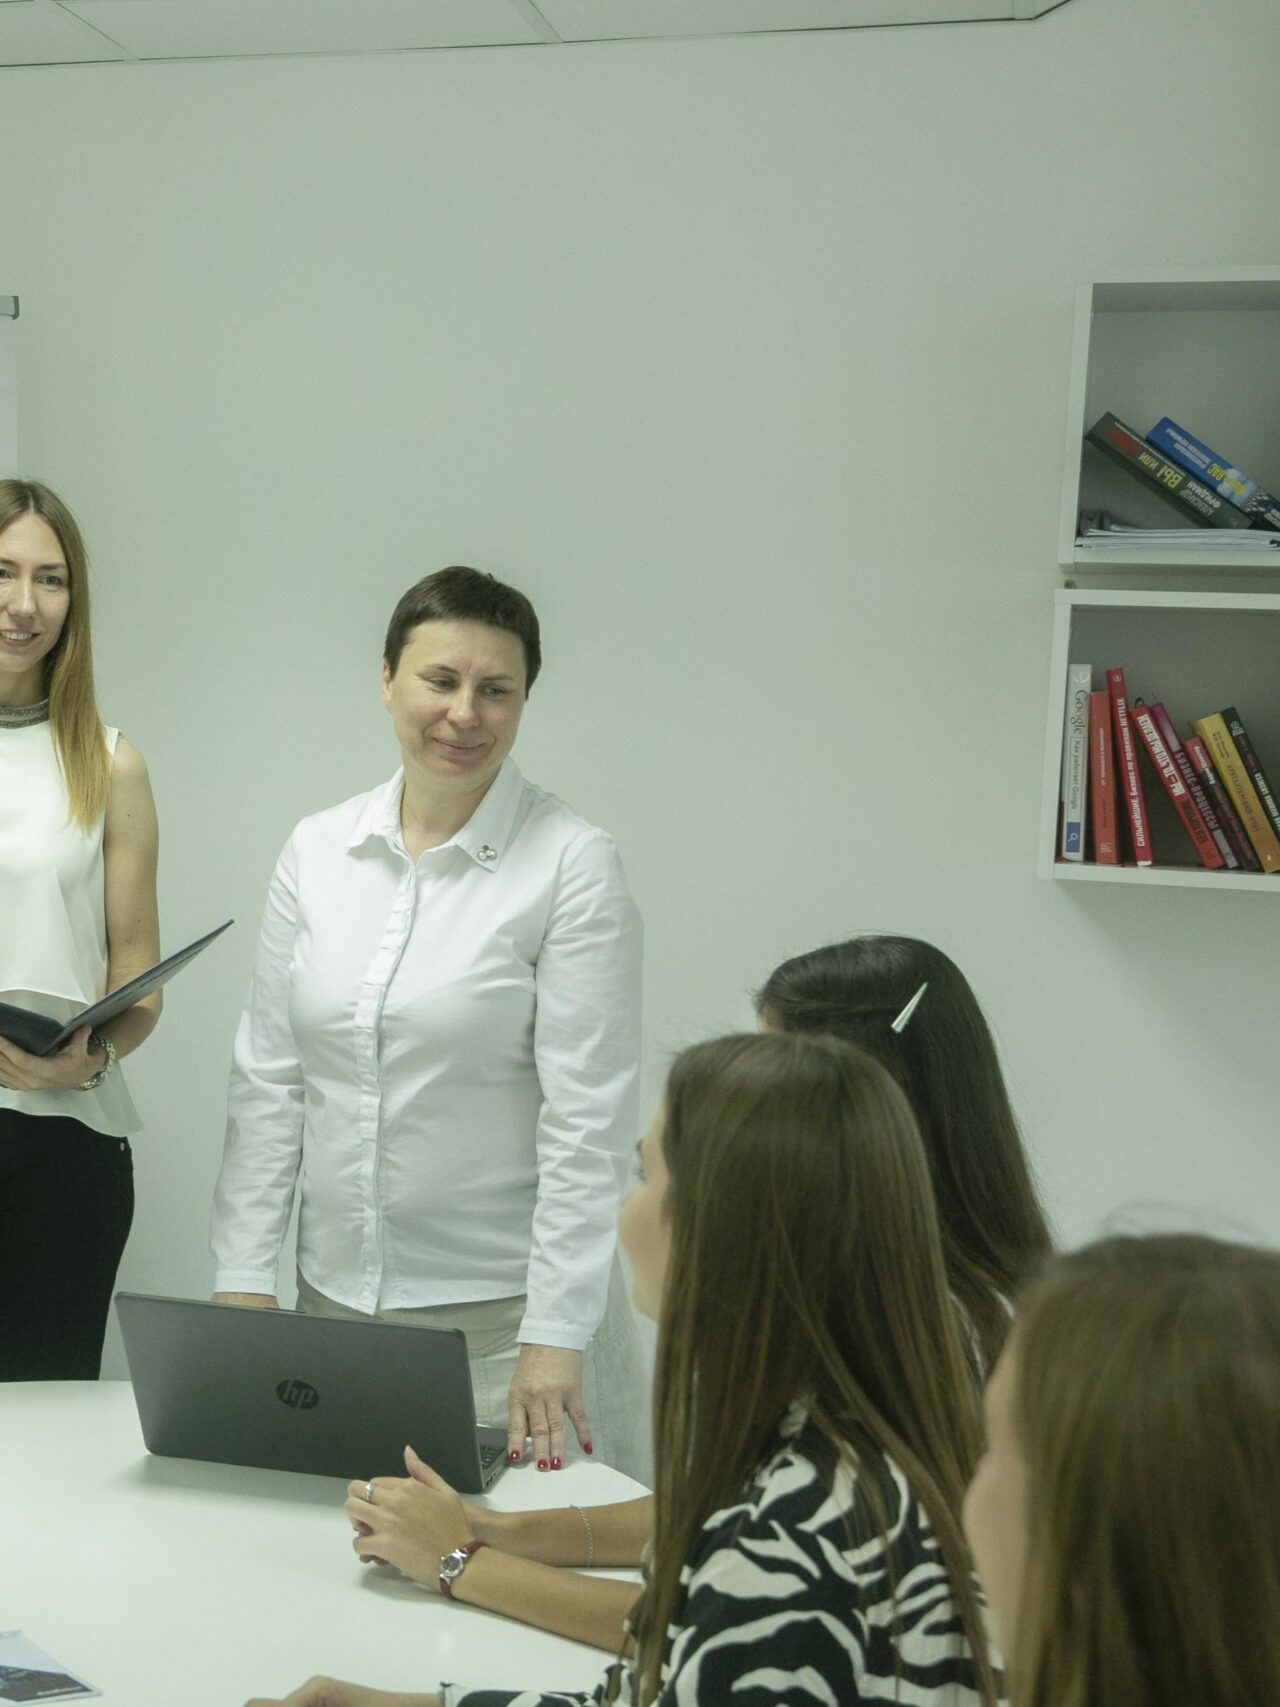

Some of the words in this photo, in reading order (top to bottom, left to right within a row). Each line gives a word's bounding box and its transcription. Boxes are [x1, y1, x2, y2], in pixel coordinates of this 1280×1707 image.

[1187, 481, 1221, 509] ФРИДМАН
[1070, 689, 1088, 735] Google
[1116, 697, 1128, 726] NETFLIX
[1126, 761, 1134, 770] по
[1069, 786, 1078, 809] Google
[1127, 771, 1138, 796] Бизнес
[1176, 750, 1220, 832] БИЗНЕС-ПРОЦЕССЫ
[279, 1380, 317, 1409] hp
